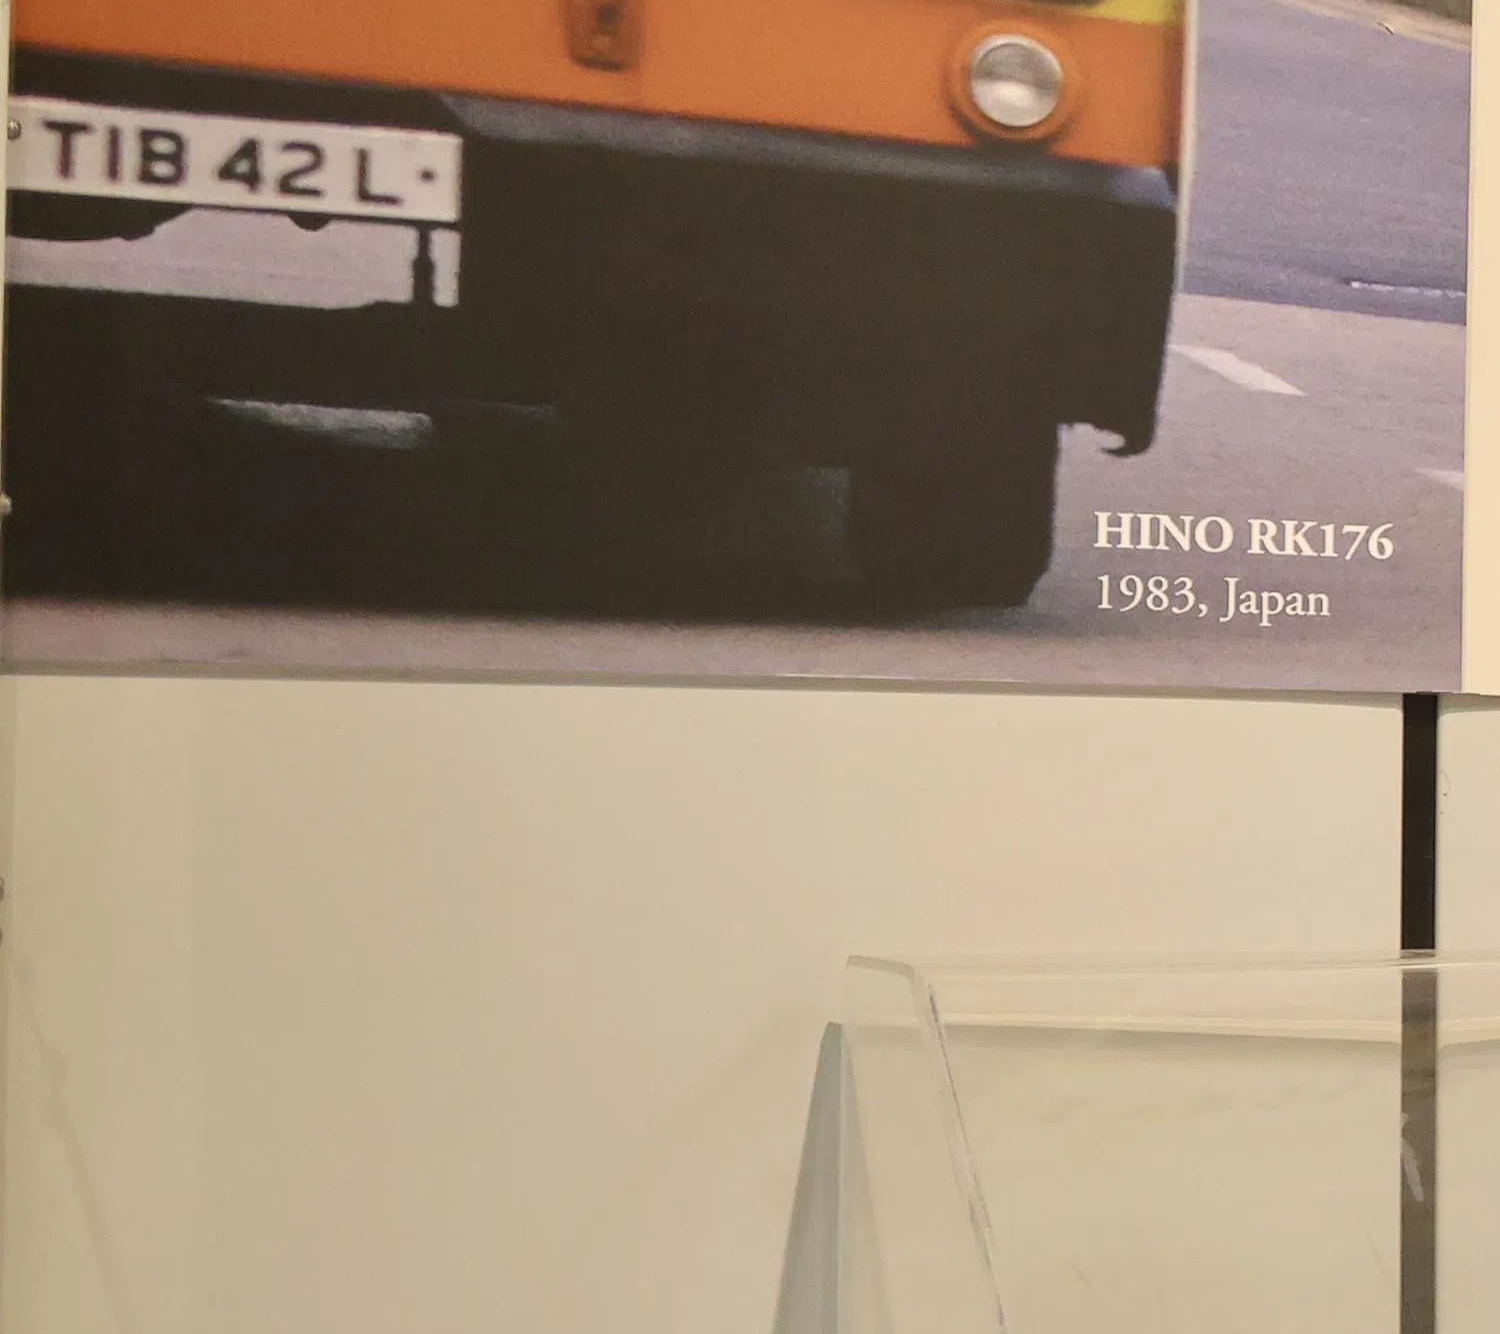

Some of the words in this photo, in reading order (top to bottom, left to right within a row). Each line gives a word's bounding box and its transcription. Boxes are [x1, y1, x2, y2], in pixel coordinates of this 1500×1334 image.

[42, 118, 187, 187] TIB
[216, 136, 325, 199] 42
[355, 147, 403, 206] L
[1093, 510, 1235, 554] HINO
[1247, 518, 1396, 561] RK176
[1096, 573, 1209, 618] 1983,
[1218, 576, 1332, 627] Japan
